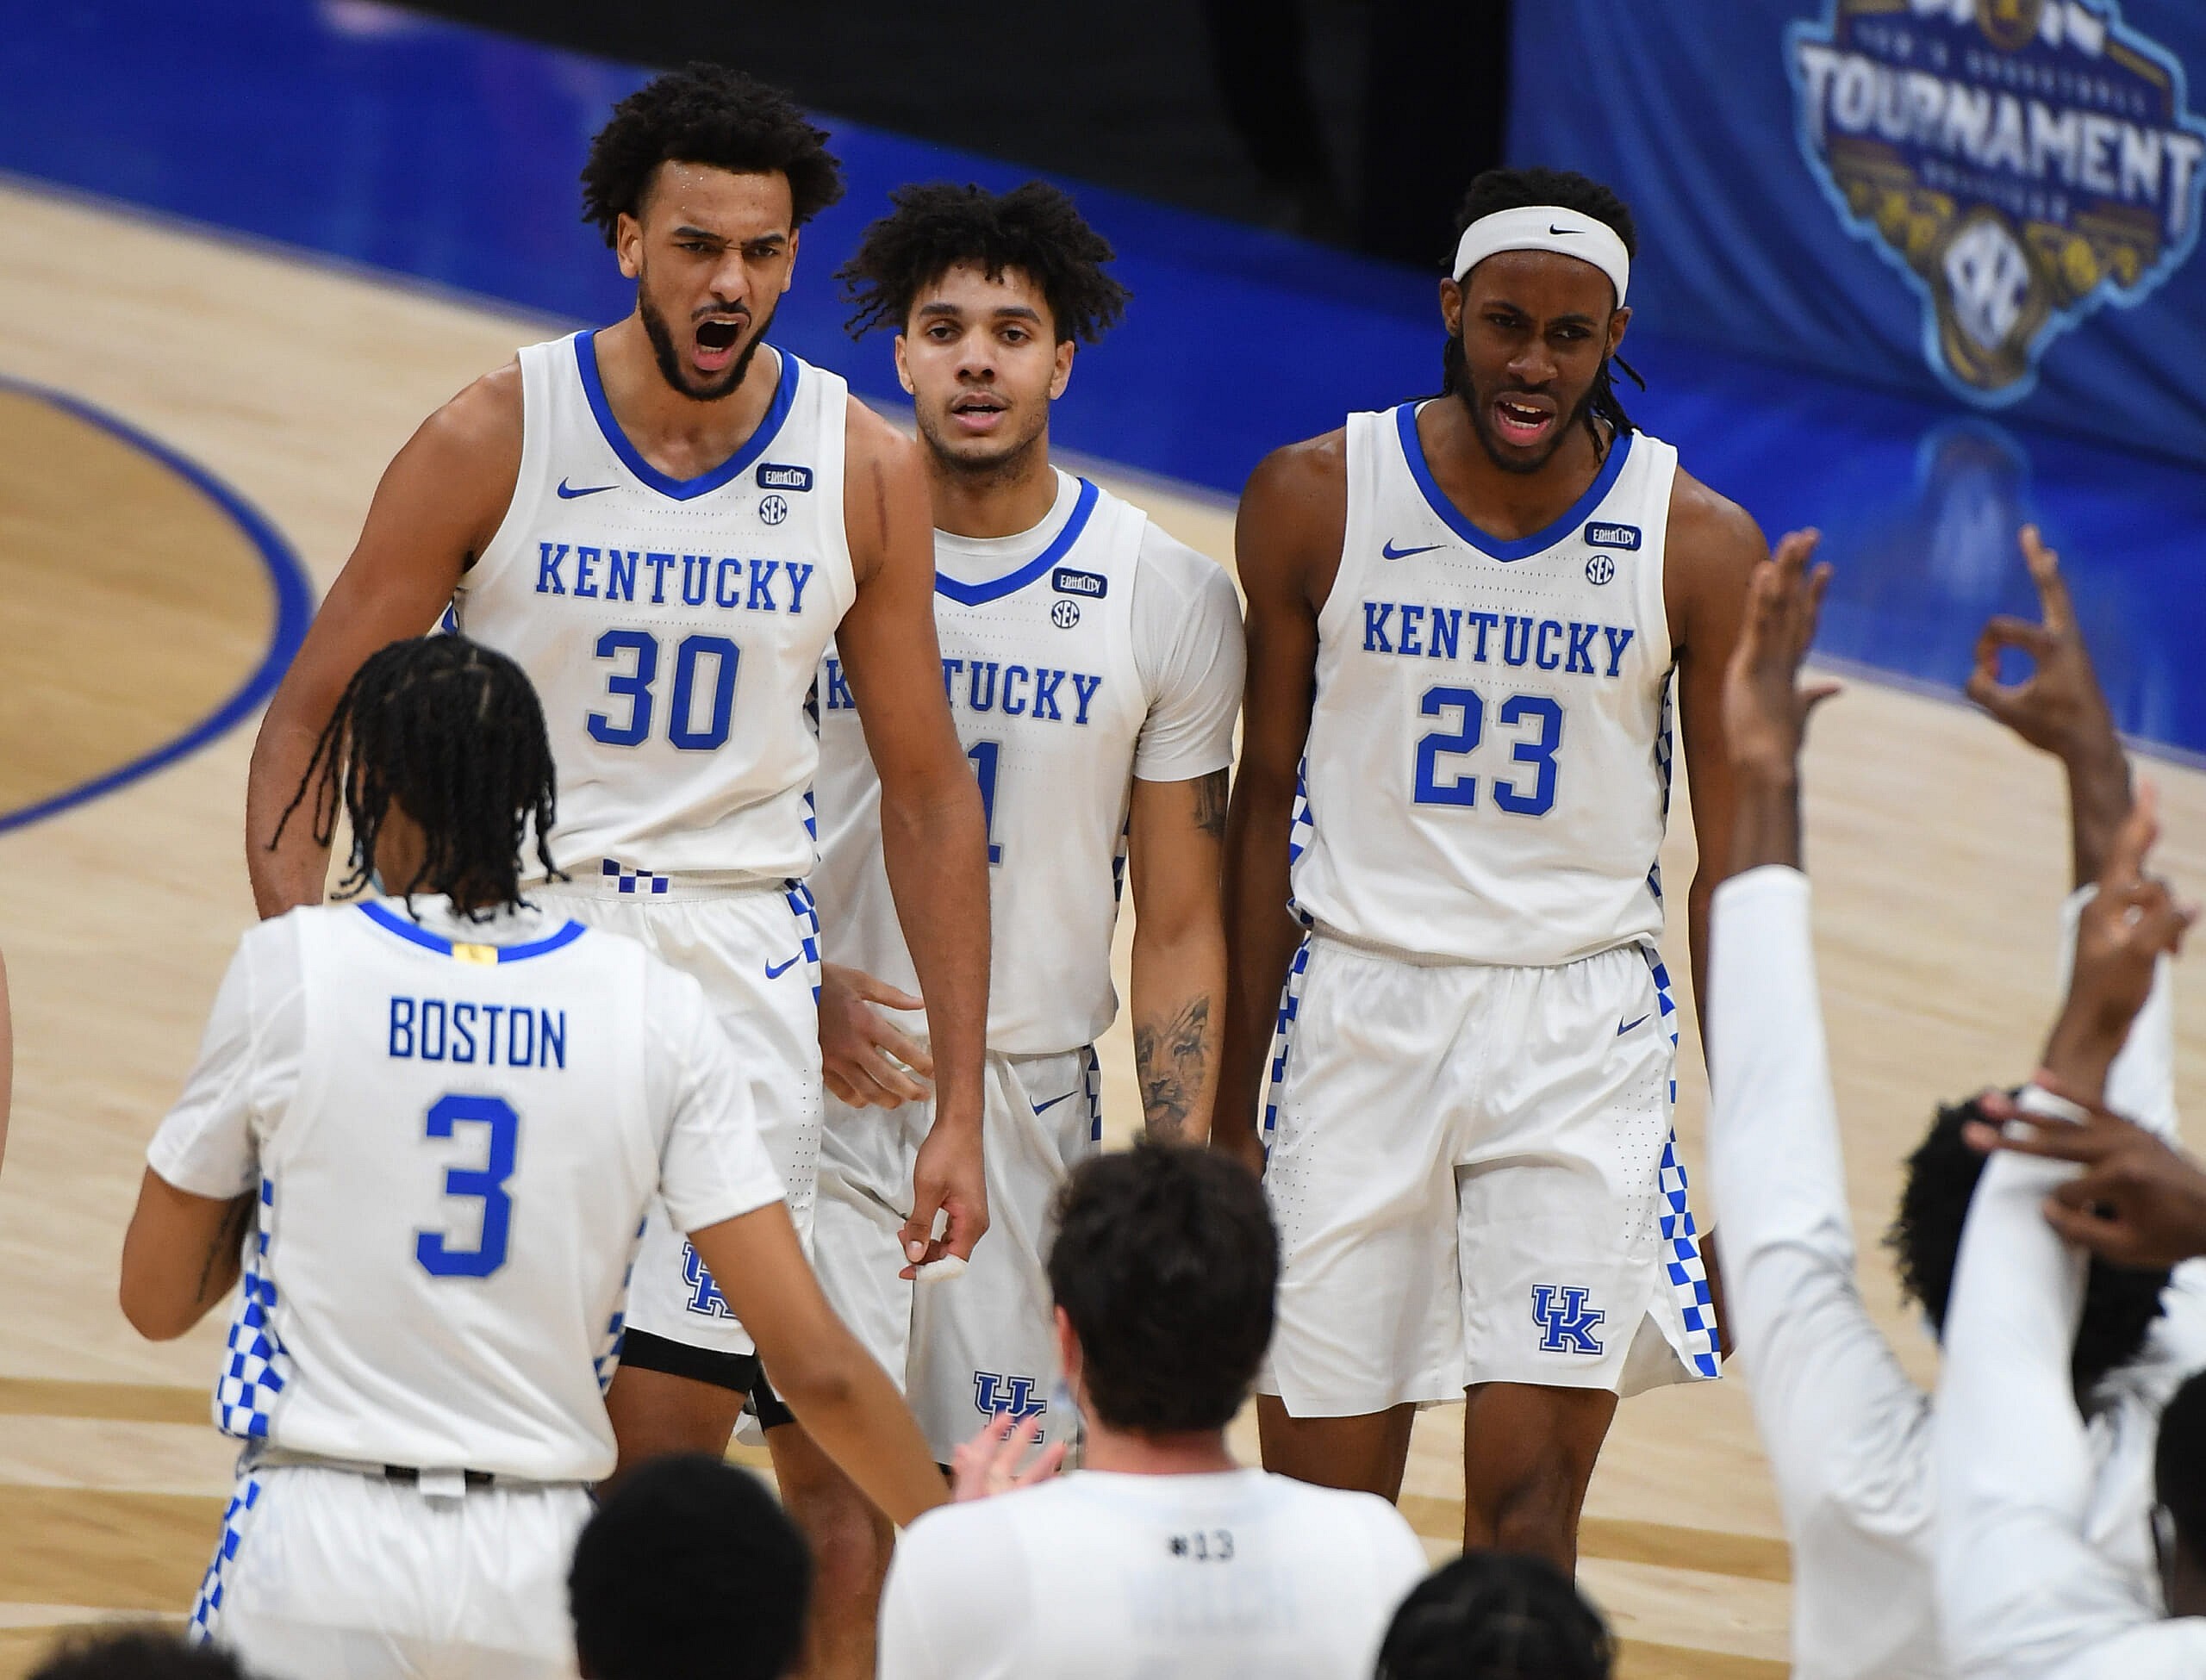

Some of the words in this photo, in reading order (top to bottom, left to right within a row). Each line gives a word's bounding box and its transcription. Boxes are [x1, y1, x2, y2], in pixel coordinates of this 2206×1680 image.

[1799, 43, 2203, 238] TOURNAMENT
[761, 495, 786, 525] SEC
[765, 469, 807, 487] EQUALITY
[1586, 556, 1614, 584] SEC
[1593, 527, 1635, 545] EQUALITY
[536, 542, 813, 613] KENTUCKY
[1060, 576, 1100, 594] EQUALITY
[1052, 600, 1079, 628] SEC
[1362, 601, 1634, 676] KENTUCKY
[587, 630, 740, 750] 30
[826, 658, 1102, 725] KTUCKY
[1413, 686, 1563, 816] 23
[389, 997, 566, 1069] BOSTON
[417, 1093, 520, 1279] 3
[1531, 1284, 1605, 1355] UK
